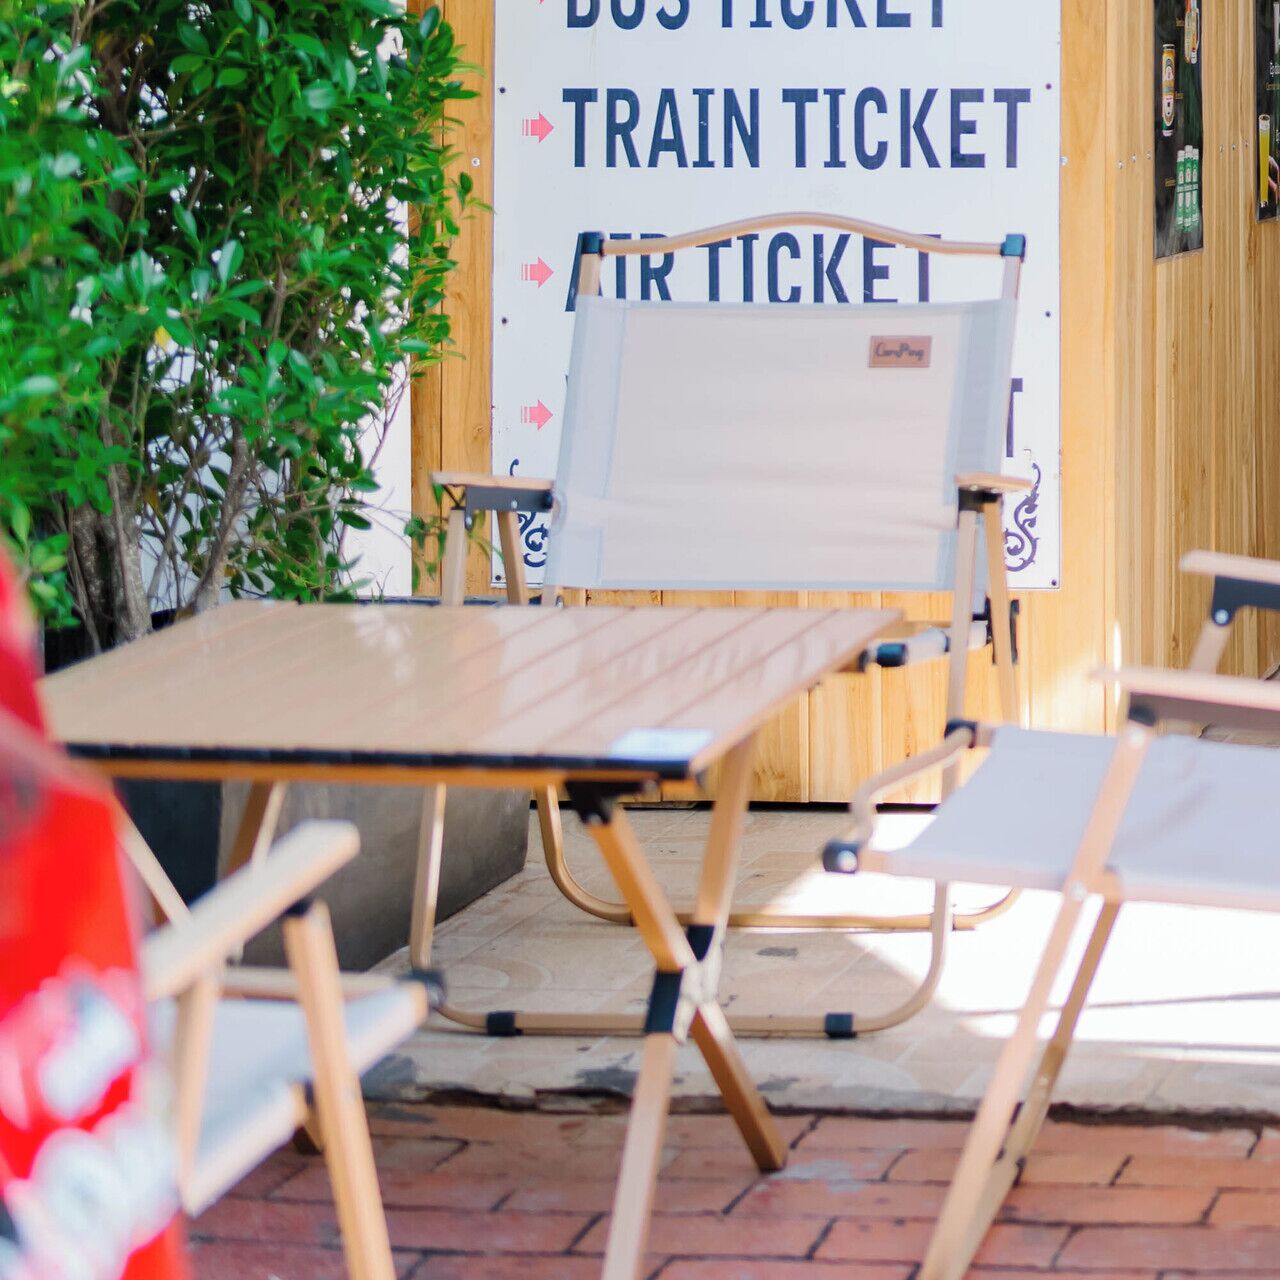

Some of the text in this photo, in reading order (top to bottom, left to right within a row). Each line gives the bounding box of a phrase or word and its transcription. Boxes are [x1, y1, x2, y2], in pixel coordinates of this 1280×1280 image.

[562, 86, 1032, 171] TRAIN TICKET
[695, 231, 942, 304] TICKET
